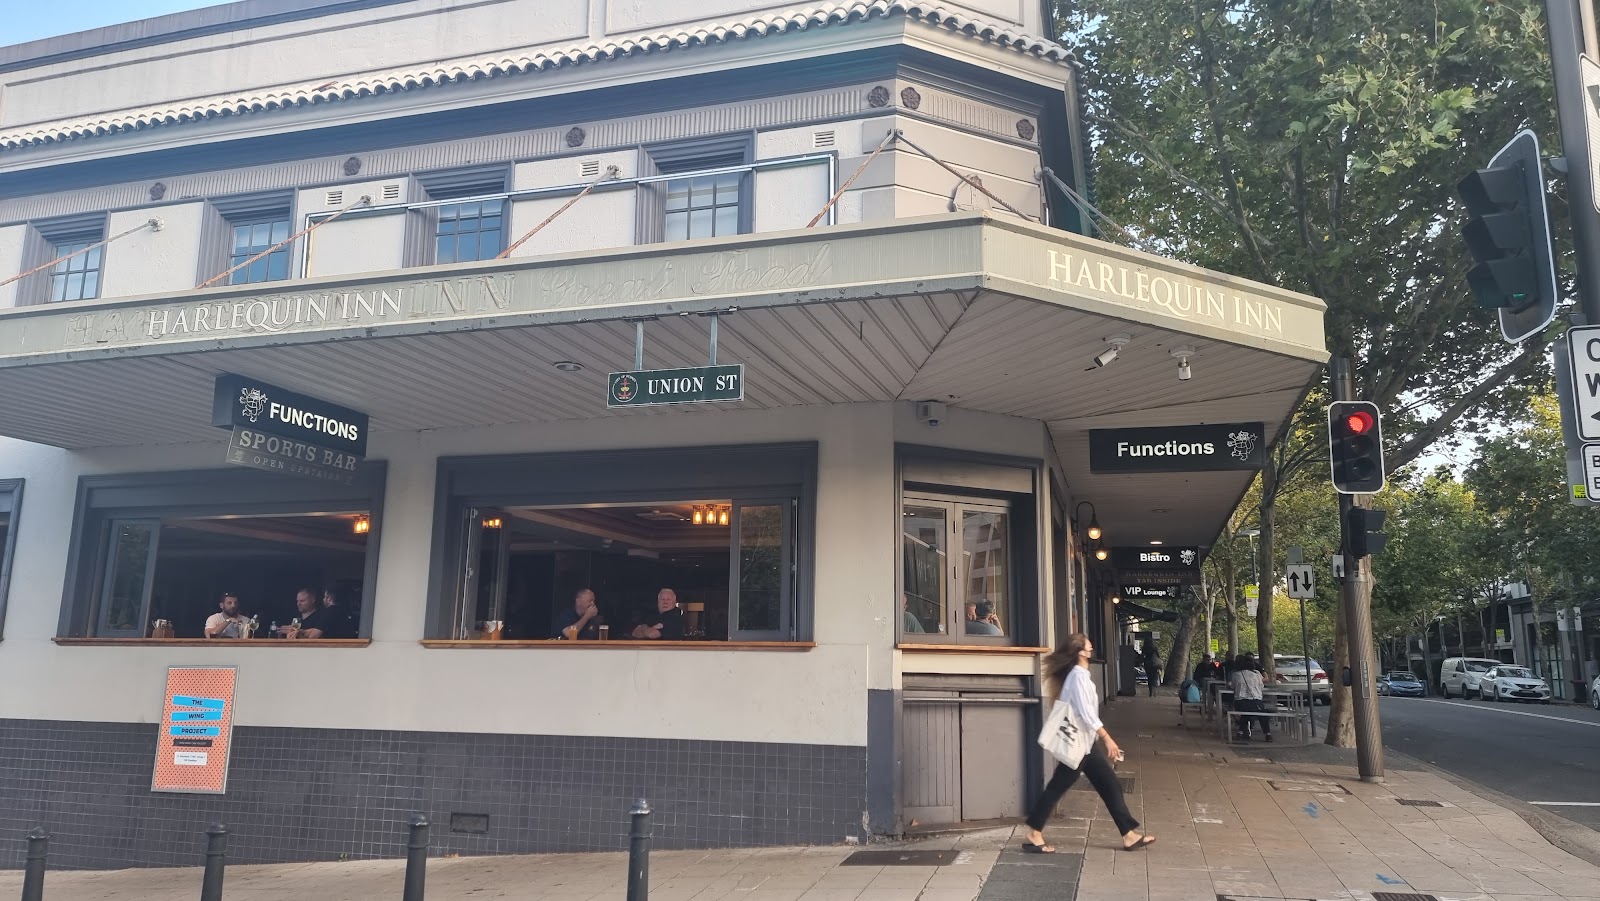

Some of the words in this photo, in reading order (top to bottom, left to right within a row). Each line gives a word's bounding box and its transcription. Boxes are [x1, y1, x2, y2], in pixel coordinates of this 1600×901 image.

[1047, 249, 1226, 320] HARLEQUIN
[1232, 295, 1283, 334] INN
[147, 294, 330, 336] HARLEQUIN
[341, 288, 404, 320] INN
[647, 376, 705, 395] UNION
[715, 374, 738, 391] ST
[269, 402, 358, 441] FUNCTIONS
[239, 430, 317, 462] SPORTS
[321, 450, 357, 472] BAR
[1117, 440, 1215, 457] Functions
[253, 455, 285, 469] OPEN
[1139, 552, 1171, 562] Bistro
[1124, 586, 1142, 595] VIP
[1143, 589, 1167, 597] Lounge
